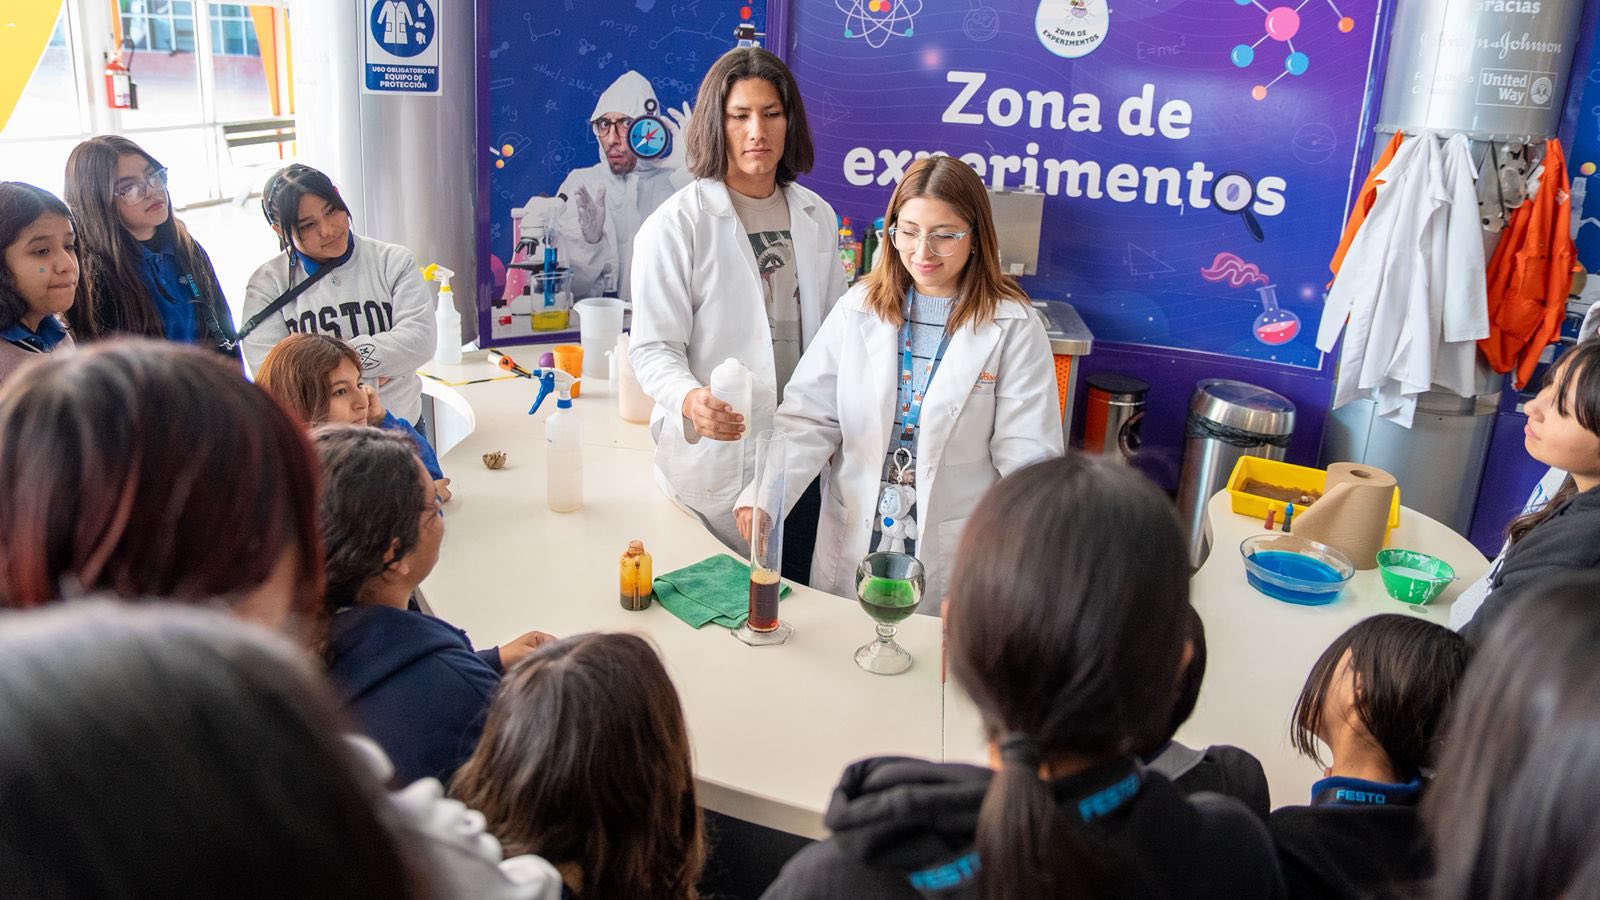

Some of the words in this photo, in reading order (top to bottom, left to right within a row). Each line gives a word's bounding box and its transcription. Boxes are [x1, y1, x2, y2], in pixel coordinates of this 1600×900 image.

[1042, 30, 1099, 46] EXPERIMENTOS
[1055, 27, 1075, 36] ZONA
[385, 73, 412, 81] EQUIPO
[1482, 72, 1528, 87] United
[1499, 87, 1525, 105] Way
[942, 70, 1102, 132] Zona
[1118, 83, 1193, 140] de
[843, 142, 1287, 217] exerimentos
[1336, 789, 1386, 805] FESTO
